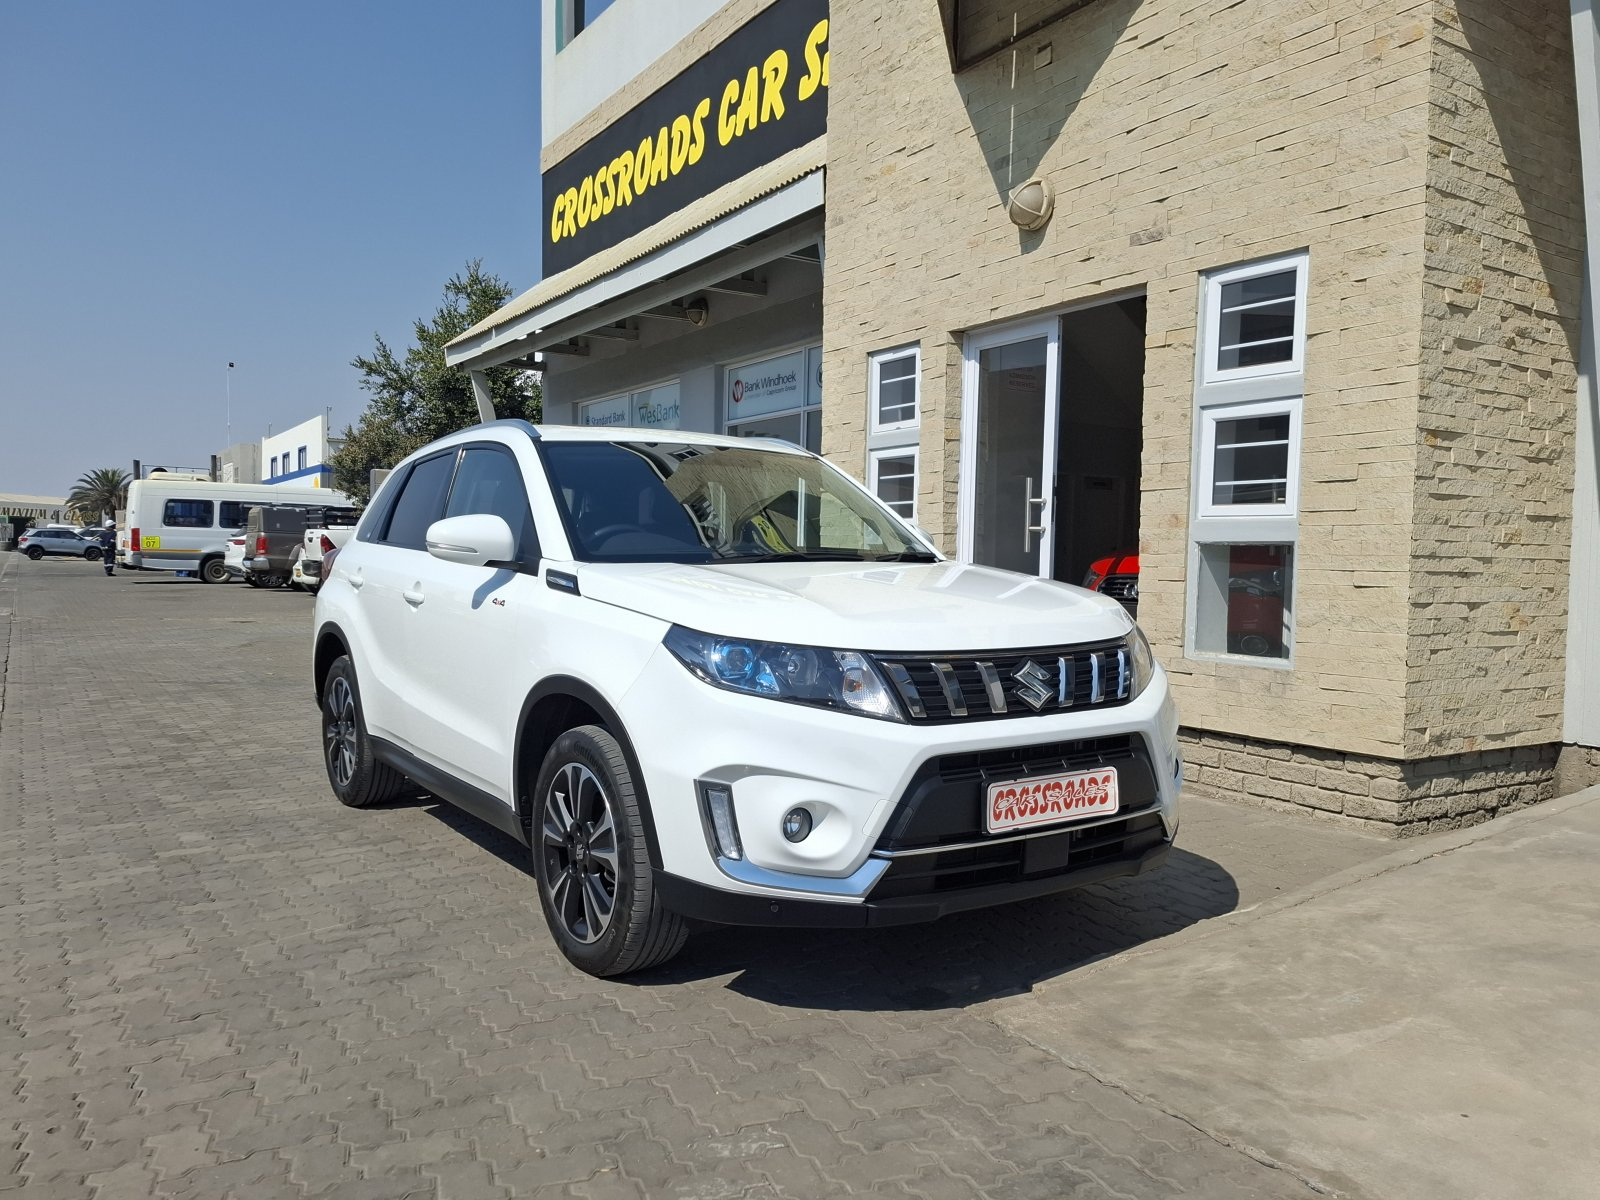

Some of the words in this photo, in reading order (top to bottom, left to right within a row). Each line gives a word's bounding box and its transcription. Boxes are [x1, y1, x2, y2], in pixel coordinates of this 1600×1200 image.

[551, 98, 711, 243] CROSSROADS
[718, 49, 788, 147] CAR
[744, 378, 760, 393] Bank
[761, 370, 797, 389] Windhoek
[591, 412, 612, 426] Standard
[612, 410, 626, 423] Bank
[638, 400, 680, 425] WesBank
[992, 774, 1111, 822] CROSSROADS
